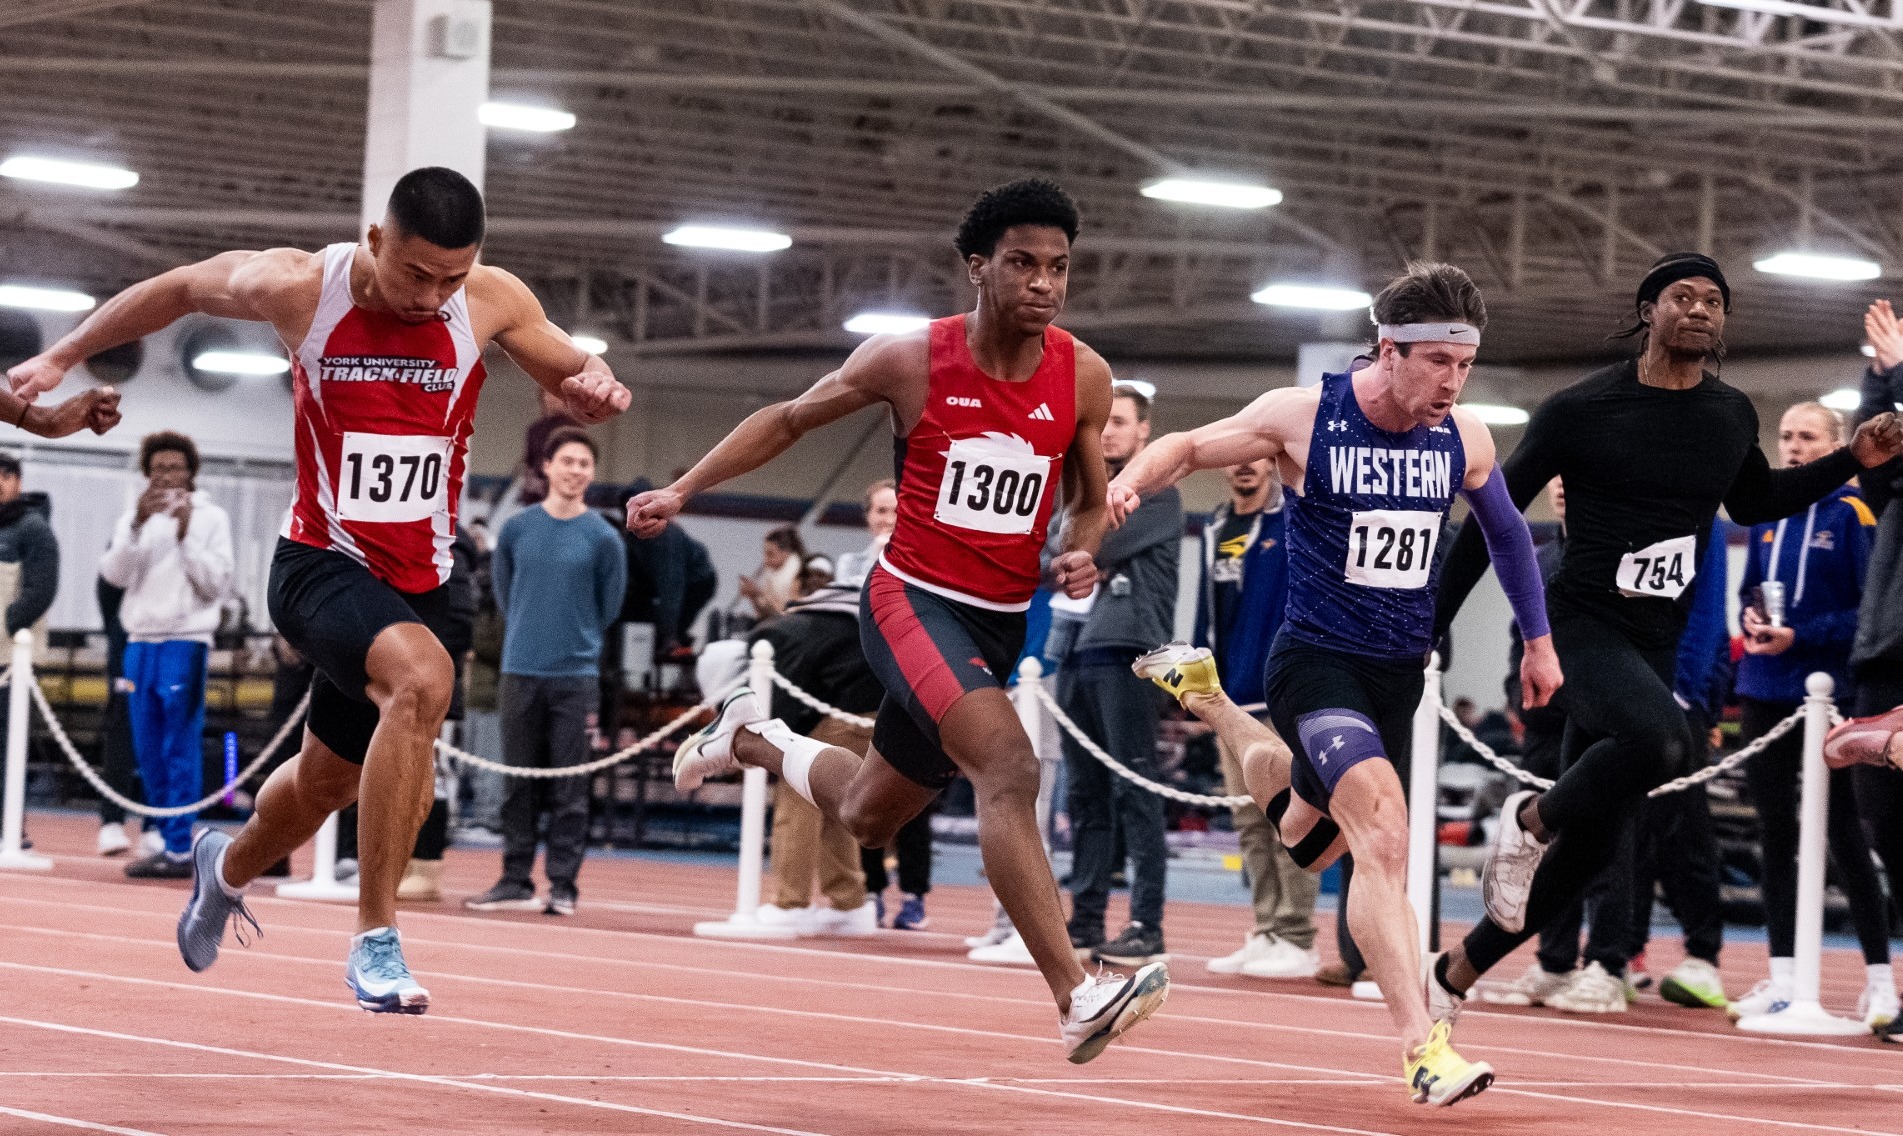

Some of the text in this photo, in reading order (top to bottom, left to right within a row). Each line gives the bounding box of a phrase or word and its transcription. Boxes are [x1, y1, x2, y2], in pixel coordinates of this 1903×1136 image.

[323, 357, 436, 368] YORK UNIVERSITY
[424, 382, 454, 393] CLUB
[946, 396, 982, 408] OUA
[347, 452, 442, 503] 1370
[948, 460, 1042, 517] 1300
[1329, 446, 1450, 499] WESTERN
[1354, 525, 1432, 571] 1281
[1633, 552, 1685, 591] 754
